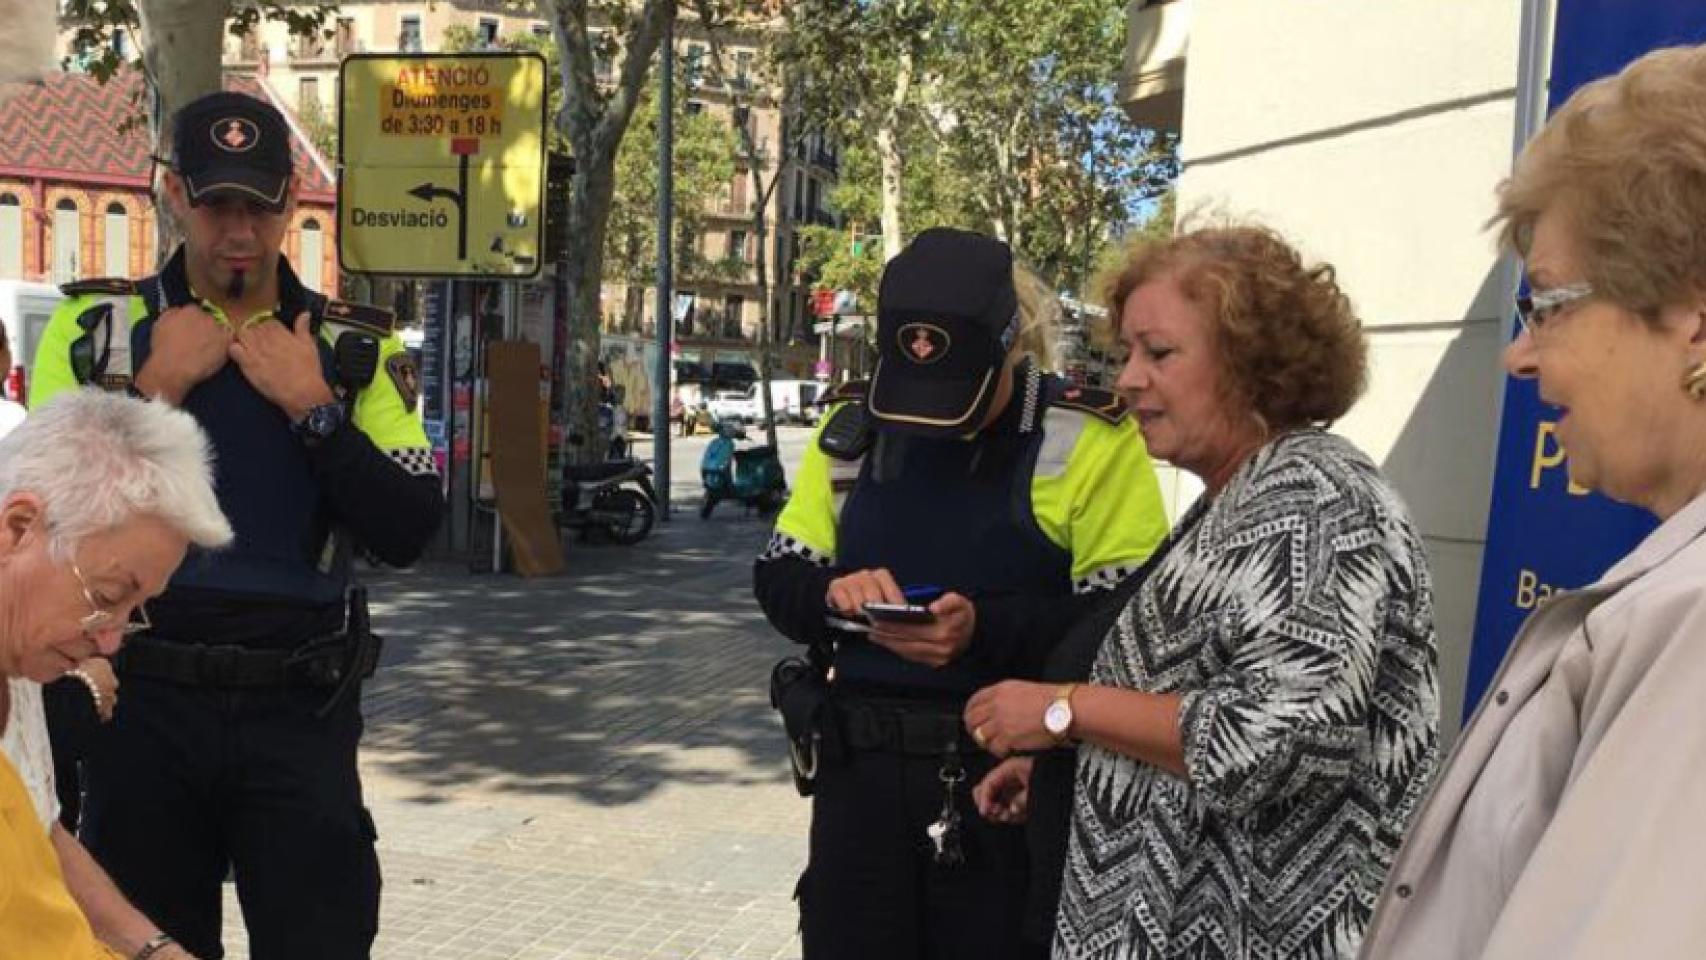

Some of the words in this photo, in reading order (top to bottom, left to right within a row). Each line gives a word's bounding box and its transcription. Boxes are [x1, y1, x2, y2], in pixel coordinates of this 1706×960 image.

[398, 63, 489, 86] ATENCIÓ
[392, 88, 491, 112] Diumenges
[381, 115, 403, 134] de
[408, 114, 443, 134] 3:30
[449, 120, 459, 134] a
[490, 116, 501, 134] h
[352, 207, 448, 228] Desviació
